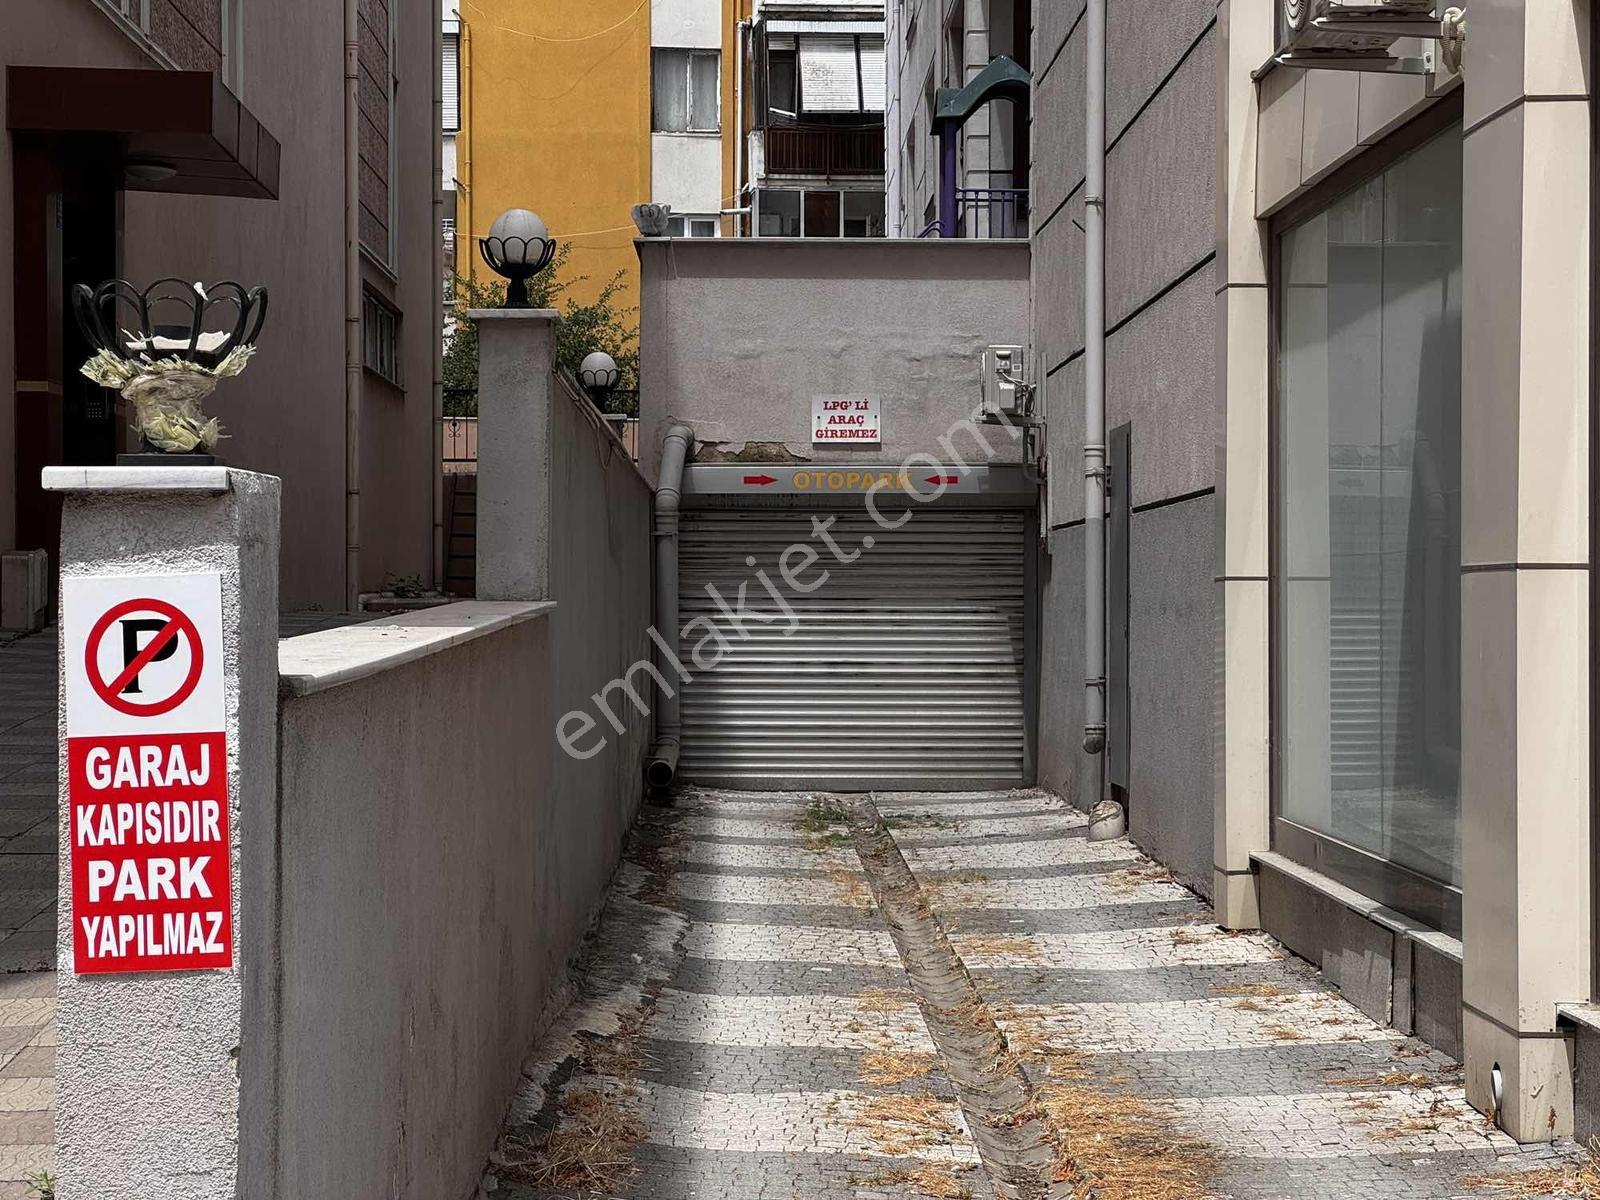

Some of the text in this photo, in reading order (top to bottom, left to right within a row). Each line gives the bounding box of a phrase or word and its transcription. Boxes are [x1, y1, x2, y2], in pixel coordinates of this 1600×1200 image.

[823, 398, 869, 411] LPG' Lİ
[827, 415, 864, 427] ARAÇ
[815, 426, 877, 439] GİREMEZ
[793, 471, 912, 491] OTOPARK
[118, 618, 179, 694] P
[85, 743, 211, 790] GARAJ
[76, 799, 222, 847] KAPISIDIR
[88, 855, 213, 903] PARK
[80, 910, 225, 959] YAPILMAZ
